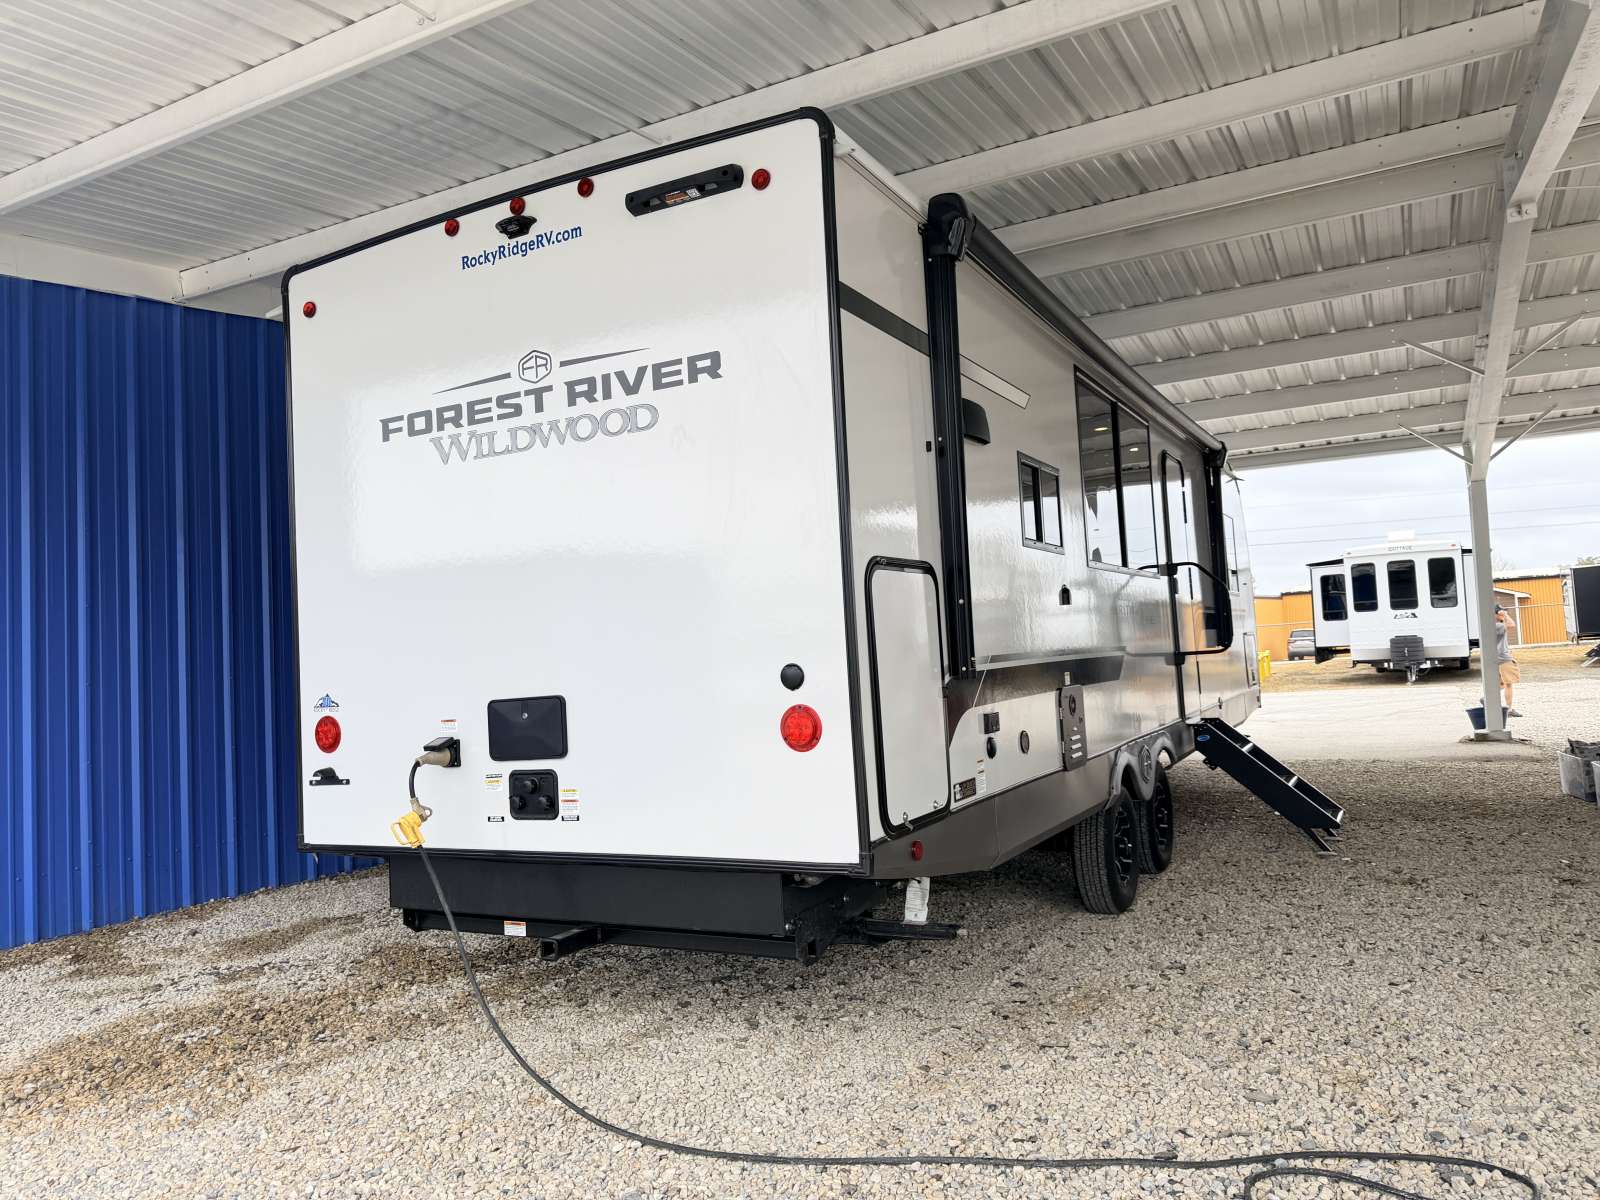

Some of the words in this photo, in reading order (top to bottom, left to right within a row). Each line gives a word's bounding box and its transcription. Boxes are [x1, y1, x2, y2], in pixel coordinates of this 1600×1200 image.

[461, 226, 583, 270] RockyRidgeRV.com
[379, 385, 553, 443] FOREST
[563, 350, 724, 407] RIVER
[429, 403, 659, 465] WILDWOOD
